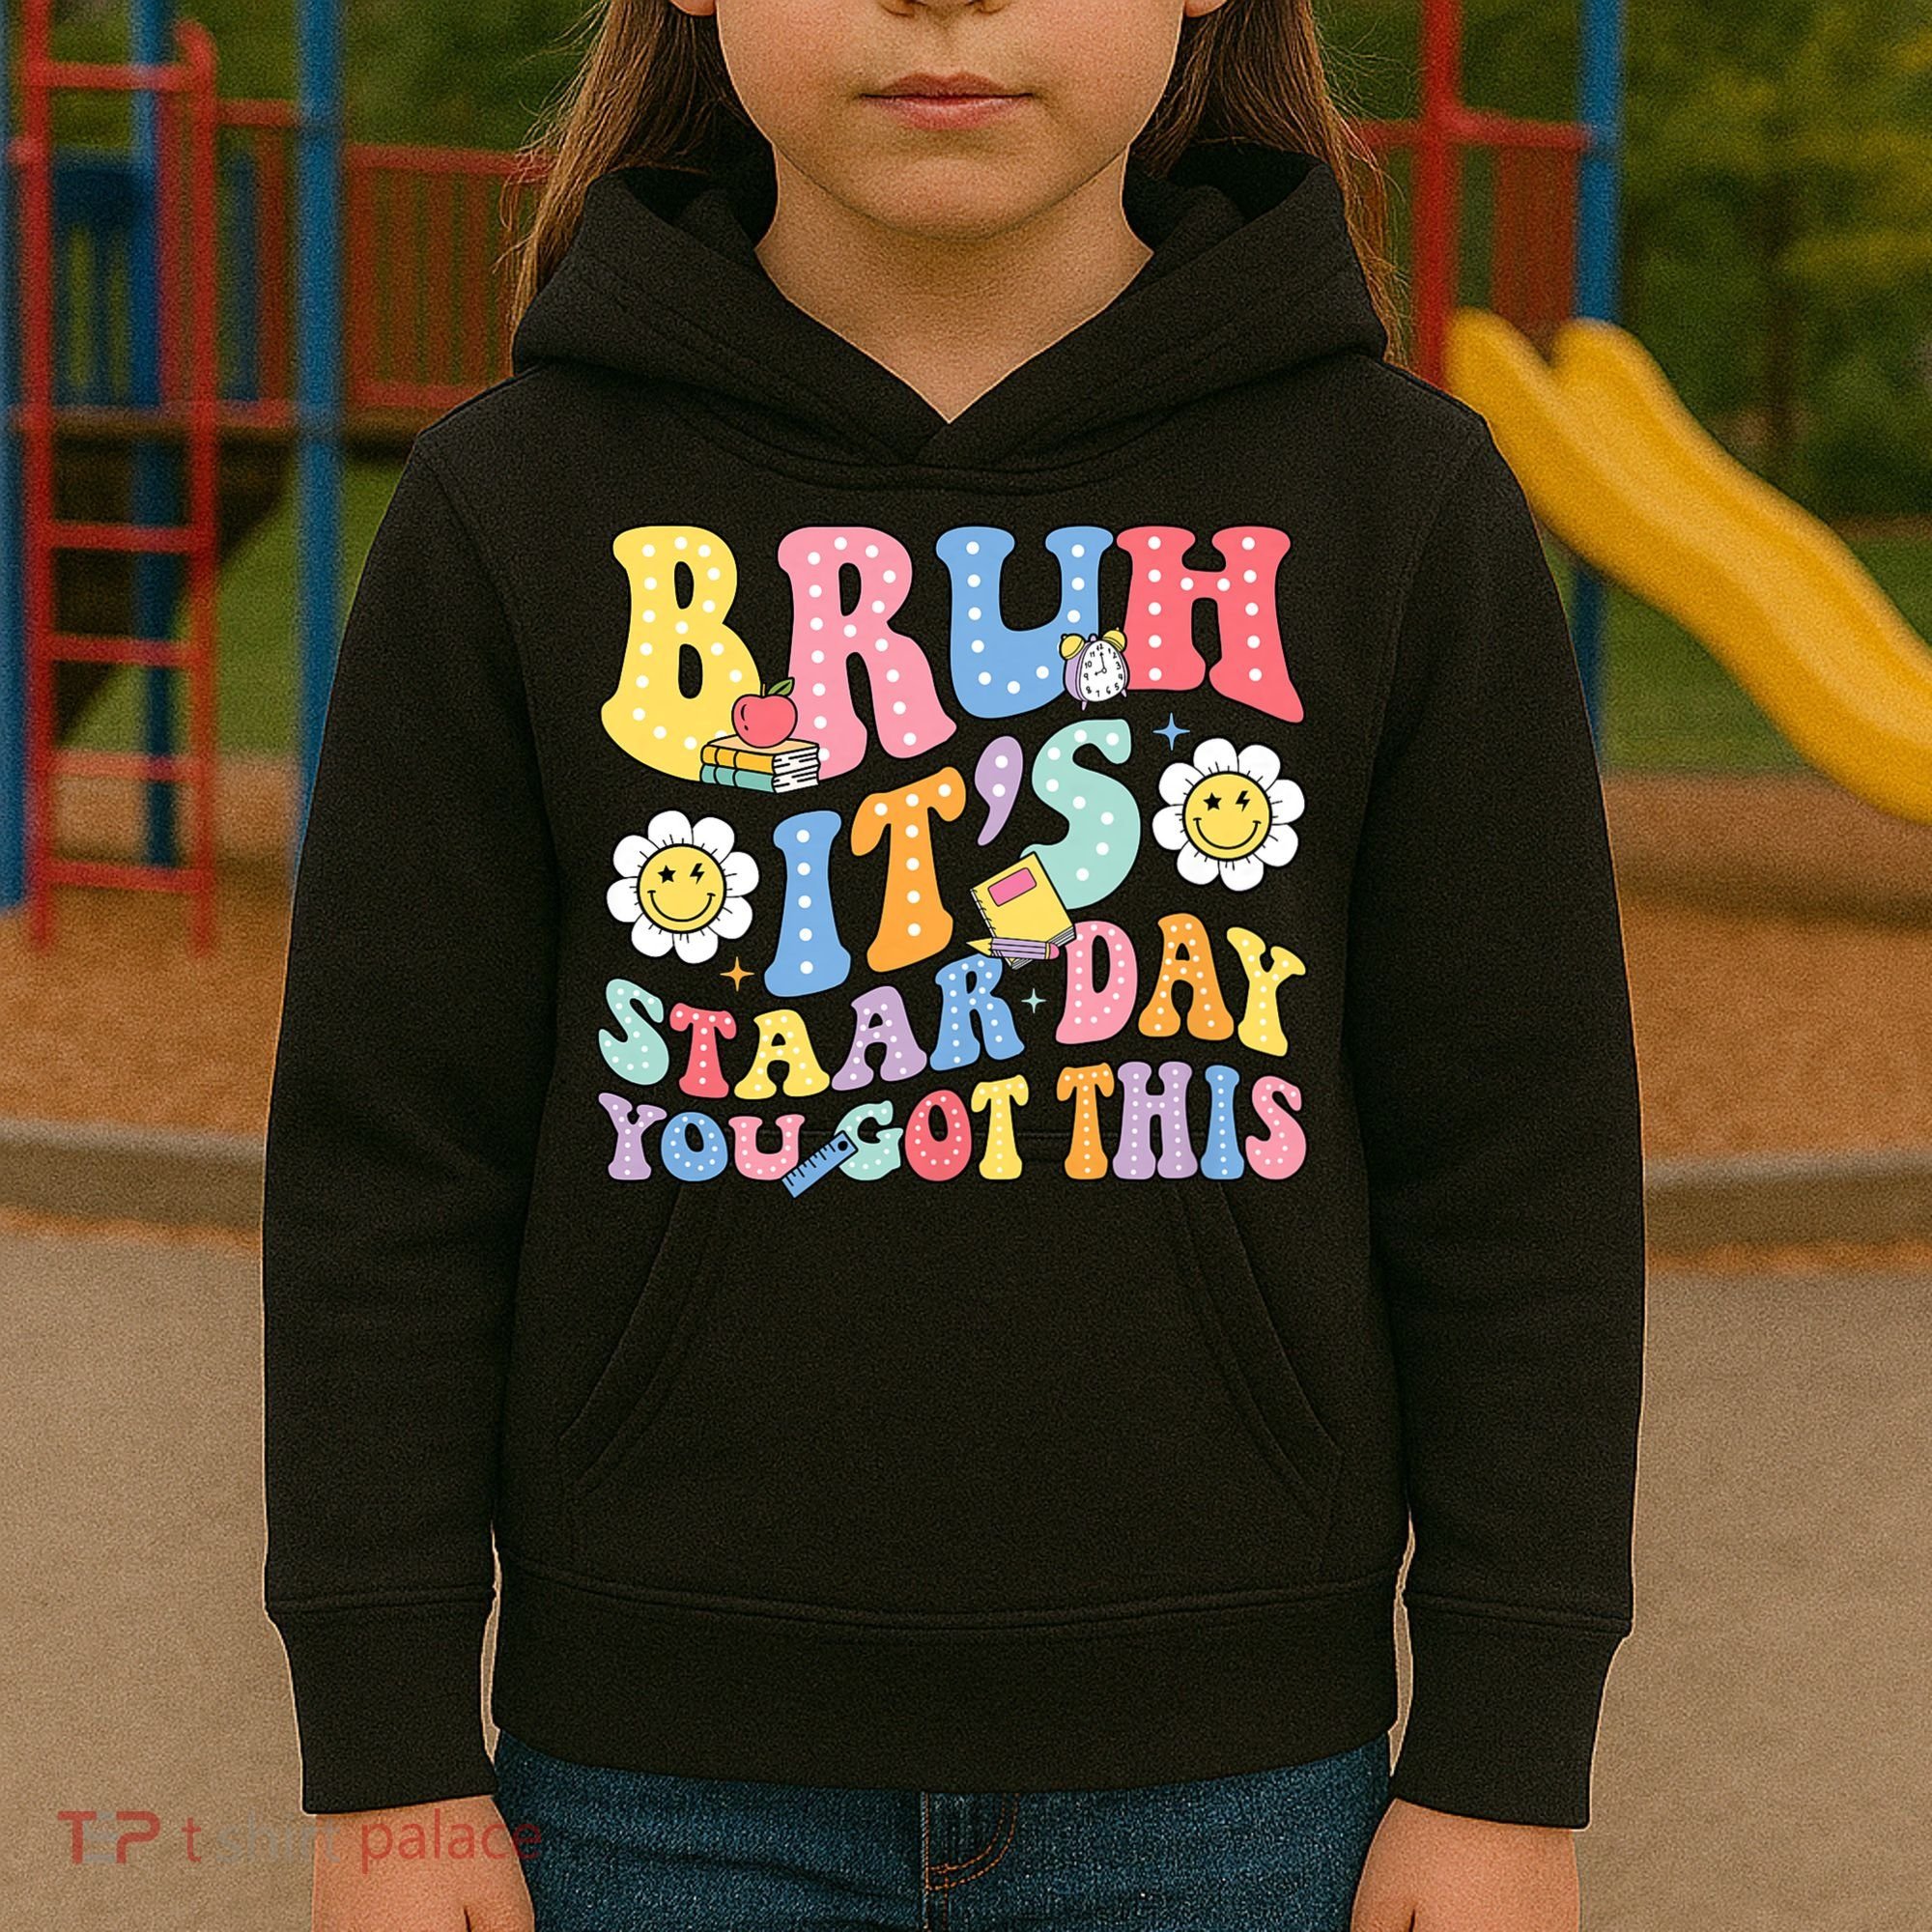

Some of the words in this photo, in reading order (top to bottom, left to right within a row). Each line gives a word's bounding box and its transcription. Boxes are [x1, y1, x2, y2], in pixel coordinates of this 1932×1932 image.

[601, 526, 1304, 781] BRUH
[763, 718, 1142, 998] IT'S
[598, 952, 1025, 1100] STAAR
[1055, 912, 1306, 1057] DAY
[597, 1092, 806, 1181] YOU
[833, 1074, 1030, 1181] GOT
[1055, 1061, 1307, 1180] THIS
